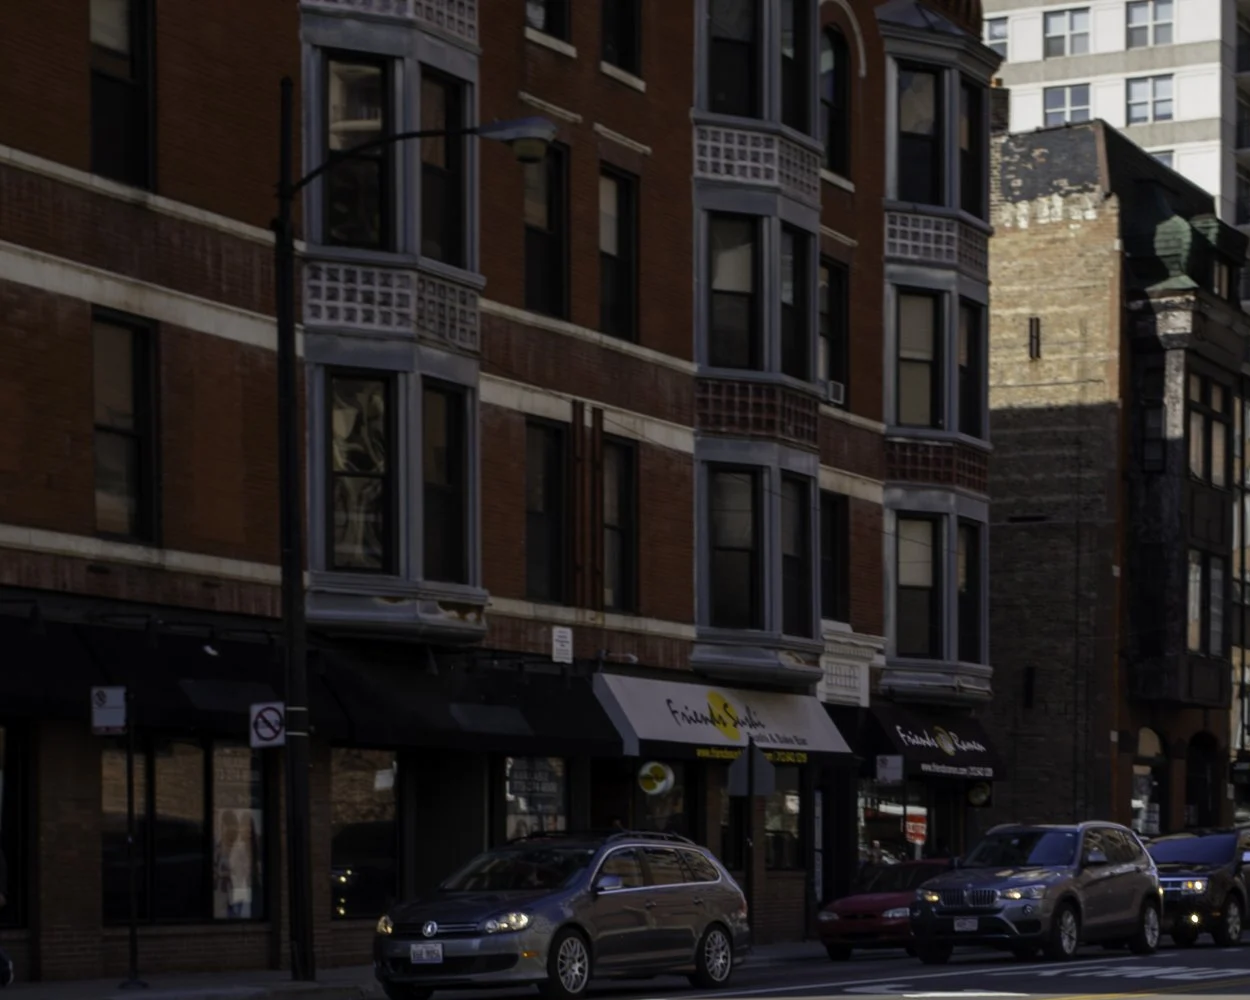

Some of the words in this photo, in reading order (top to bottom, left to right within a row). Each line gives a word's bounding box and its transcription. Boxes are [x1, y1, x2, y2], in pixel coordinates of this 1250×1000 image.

[666, 698, 727, 728] Friends
[723, 703, 766, 730] Sushi
[895, 724, 939, 749] Friends
